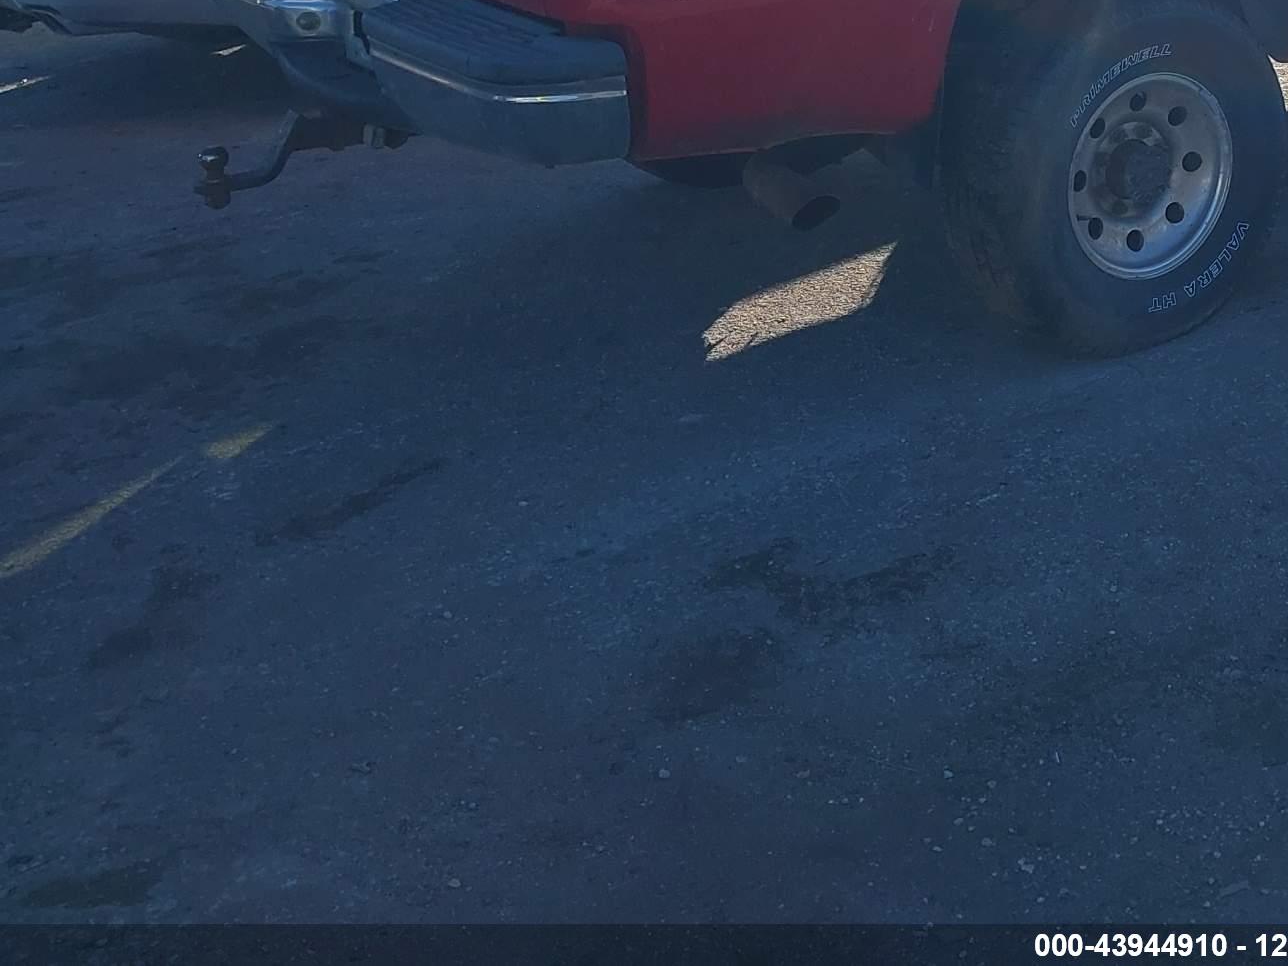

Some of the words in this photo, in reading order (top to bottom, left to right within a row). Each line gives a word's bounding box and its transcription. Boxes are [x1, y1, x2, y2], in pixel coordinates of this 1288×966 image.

[1069, 42, 1173, 129] PRIMEWELL
[1183, 222, 1250, 298] VALERA
[1147, 292, 1178, 313] HT
